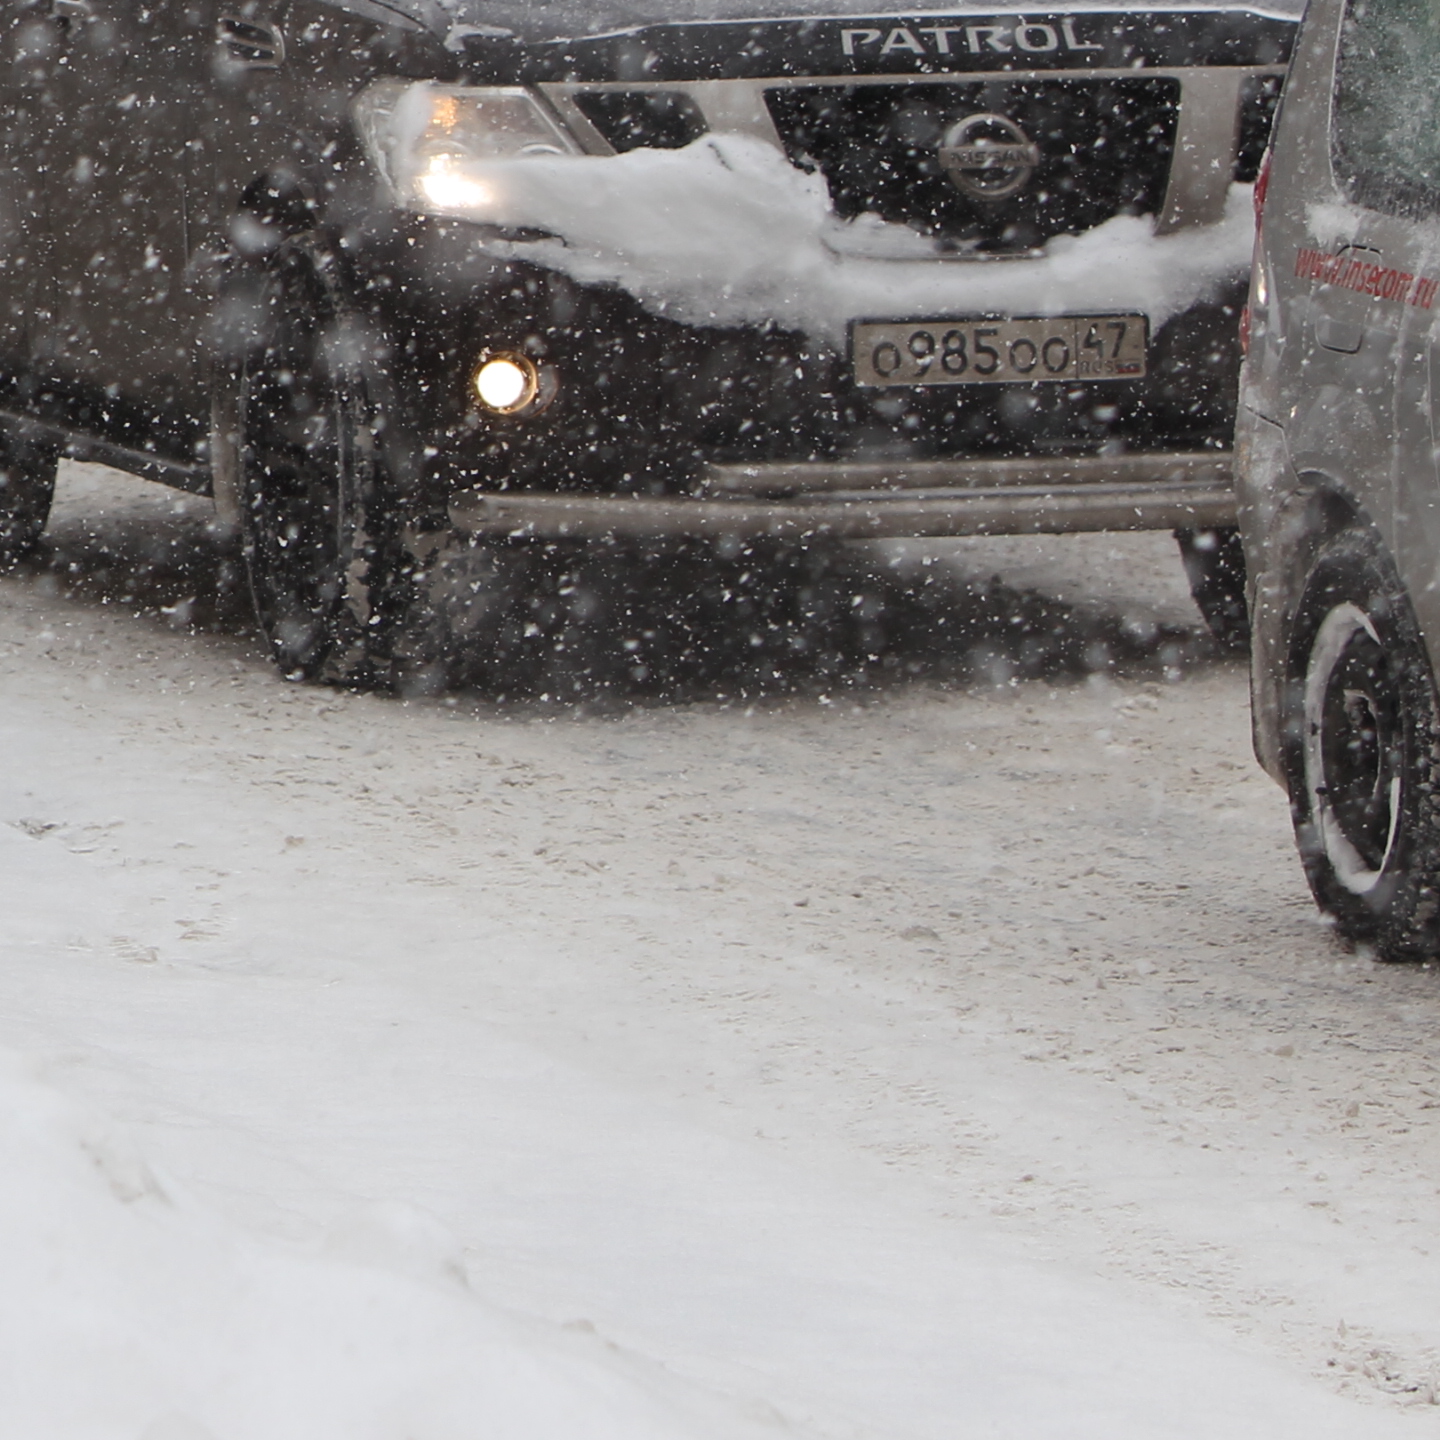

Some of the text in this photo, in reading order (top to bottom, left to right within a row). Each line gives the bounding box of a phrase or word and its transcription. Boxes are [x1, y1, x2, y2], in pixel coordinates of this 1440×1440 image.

[841, 23, 1104, 56] PATROL
[950, 149, 1031, 166] NISSAN
[1294, 247, 1439, 310] www.insecom.ru
[1083, 322, 1126, 359] 47
